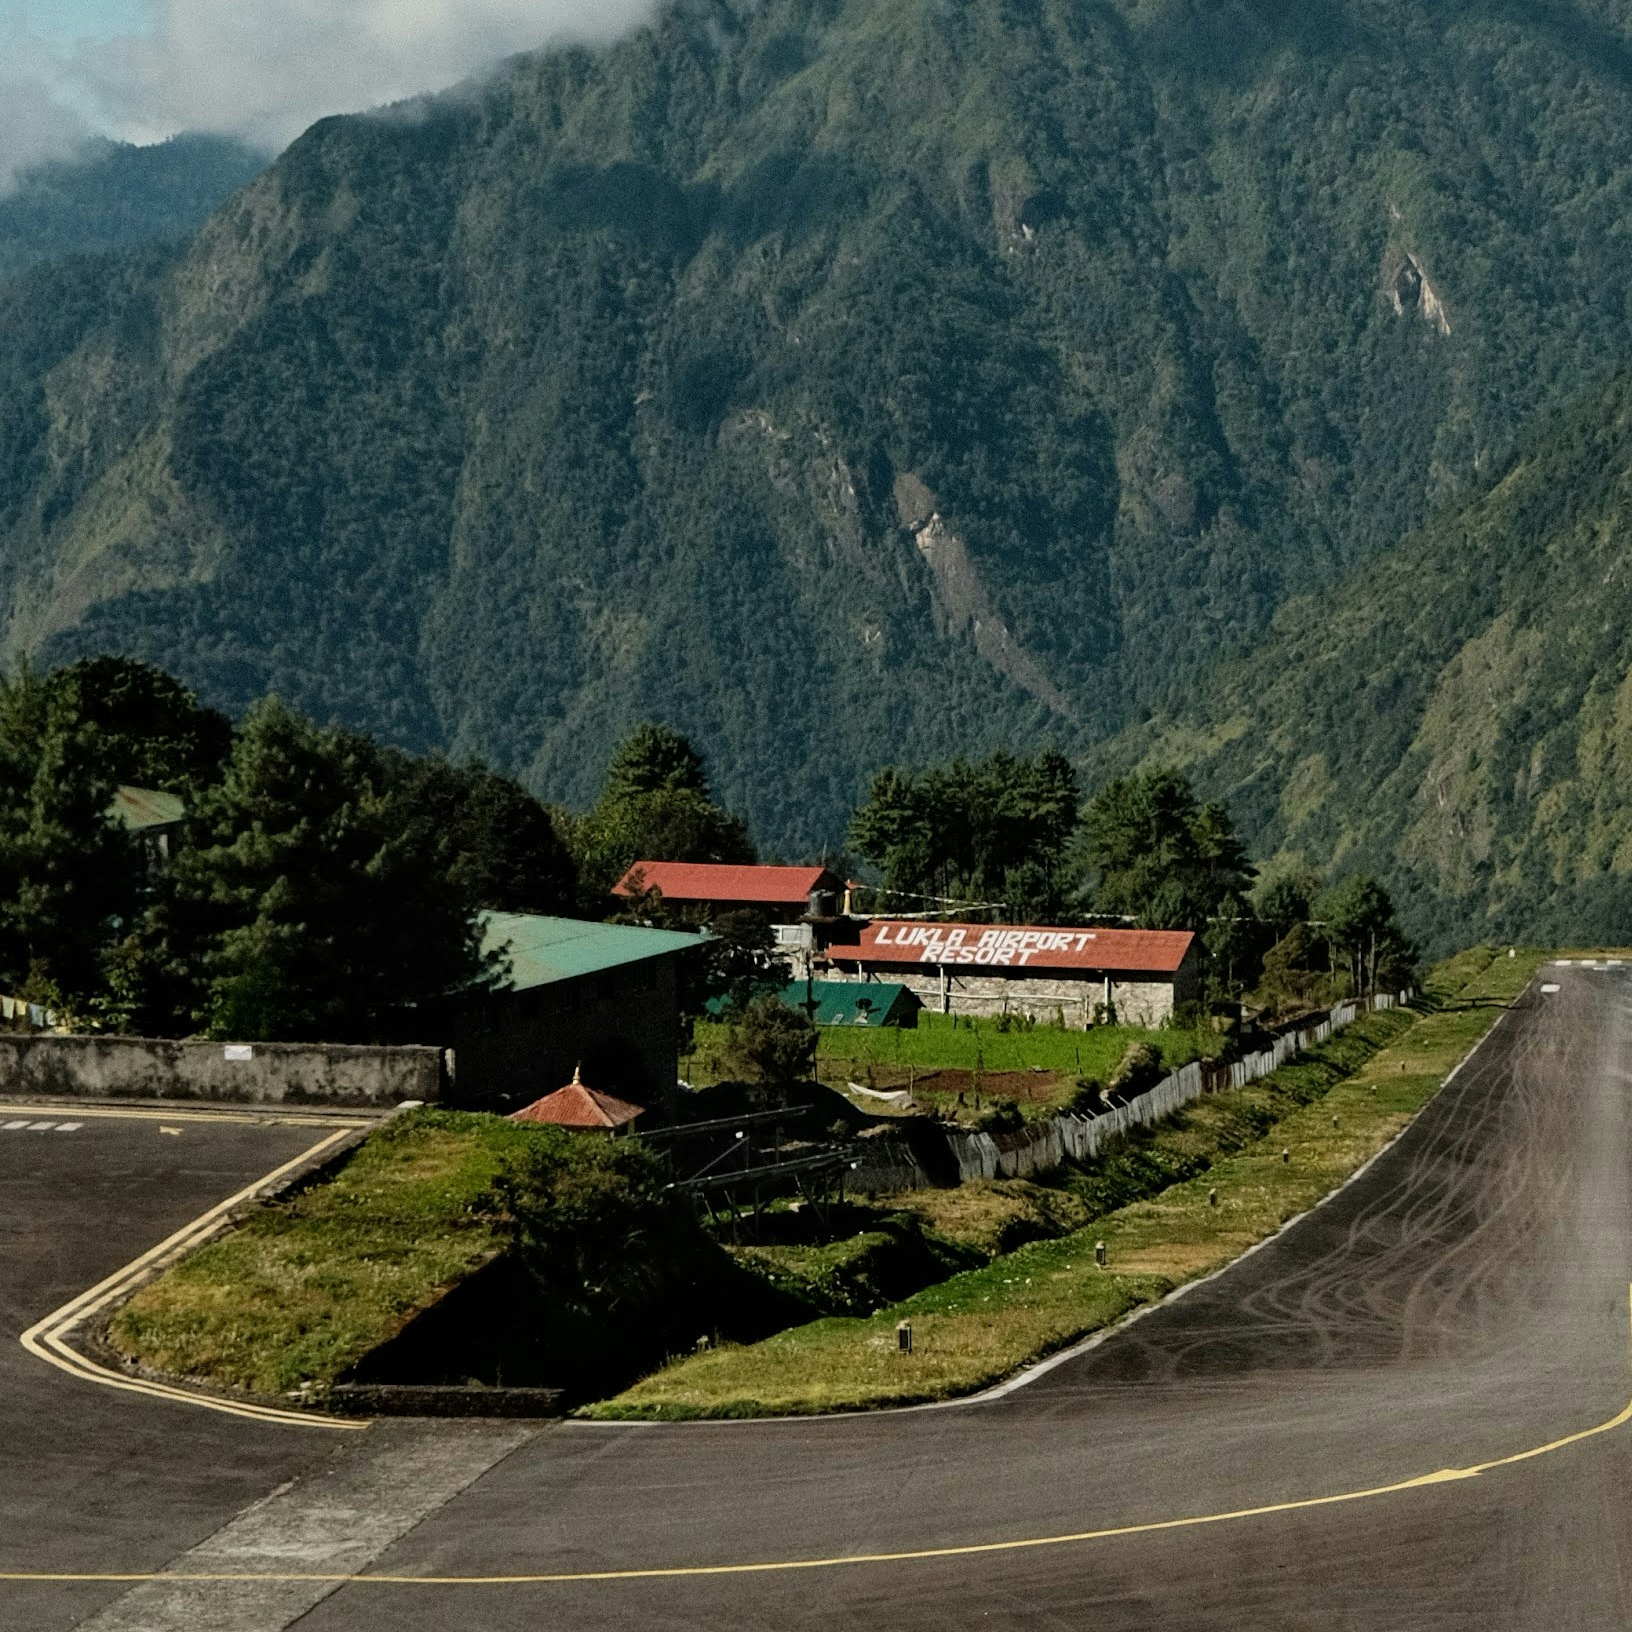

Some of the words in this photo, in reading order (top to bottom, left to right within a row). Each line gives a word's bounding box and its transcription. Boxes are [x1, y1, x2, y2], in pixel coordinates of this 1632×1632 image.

[875, 926, 967, 948] LUKLA
[977, 929, 1096, 952] AIRPORT
[919, 944, 1039, 965] RESORT
